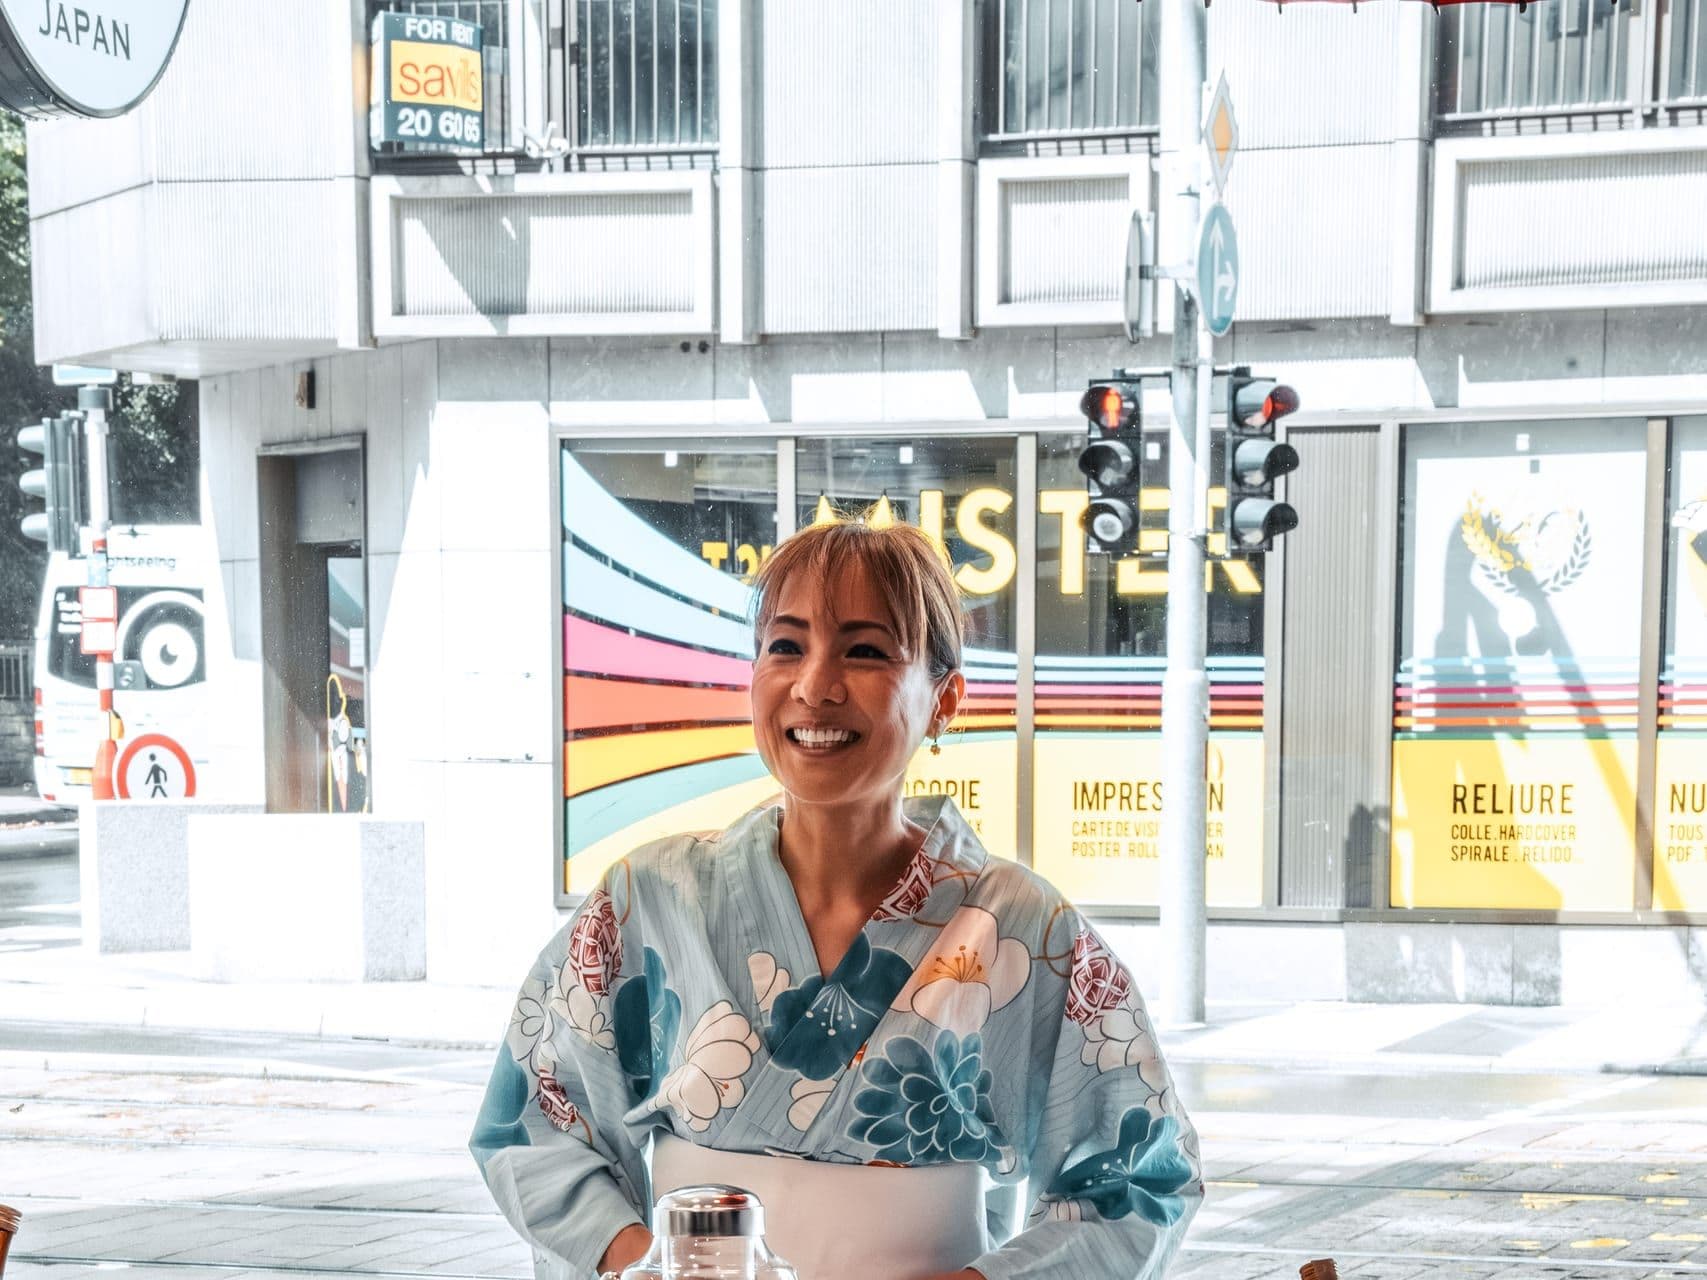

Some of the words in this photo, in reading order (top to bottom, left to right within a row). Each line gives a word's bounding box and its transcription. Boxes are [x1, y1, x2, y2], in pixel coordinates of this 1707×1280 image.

[39, 0, 131, 60] JAPAN
[405, 17, 447, 40] FOR
[397, 107, 432, 137] 20
[1452, 784, 1574, 814] RELIURE
